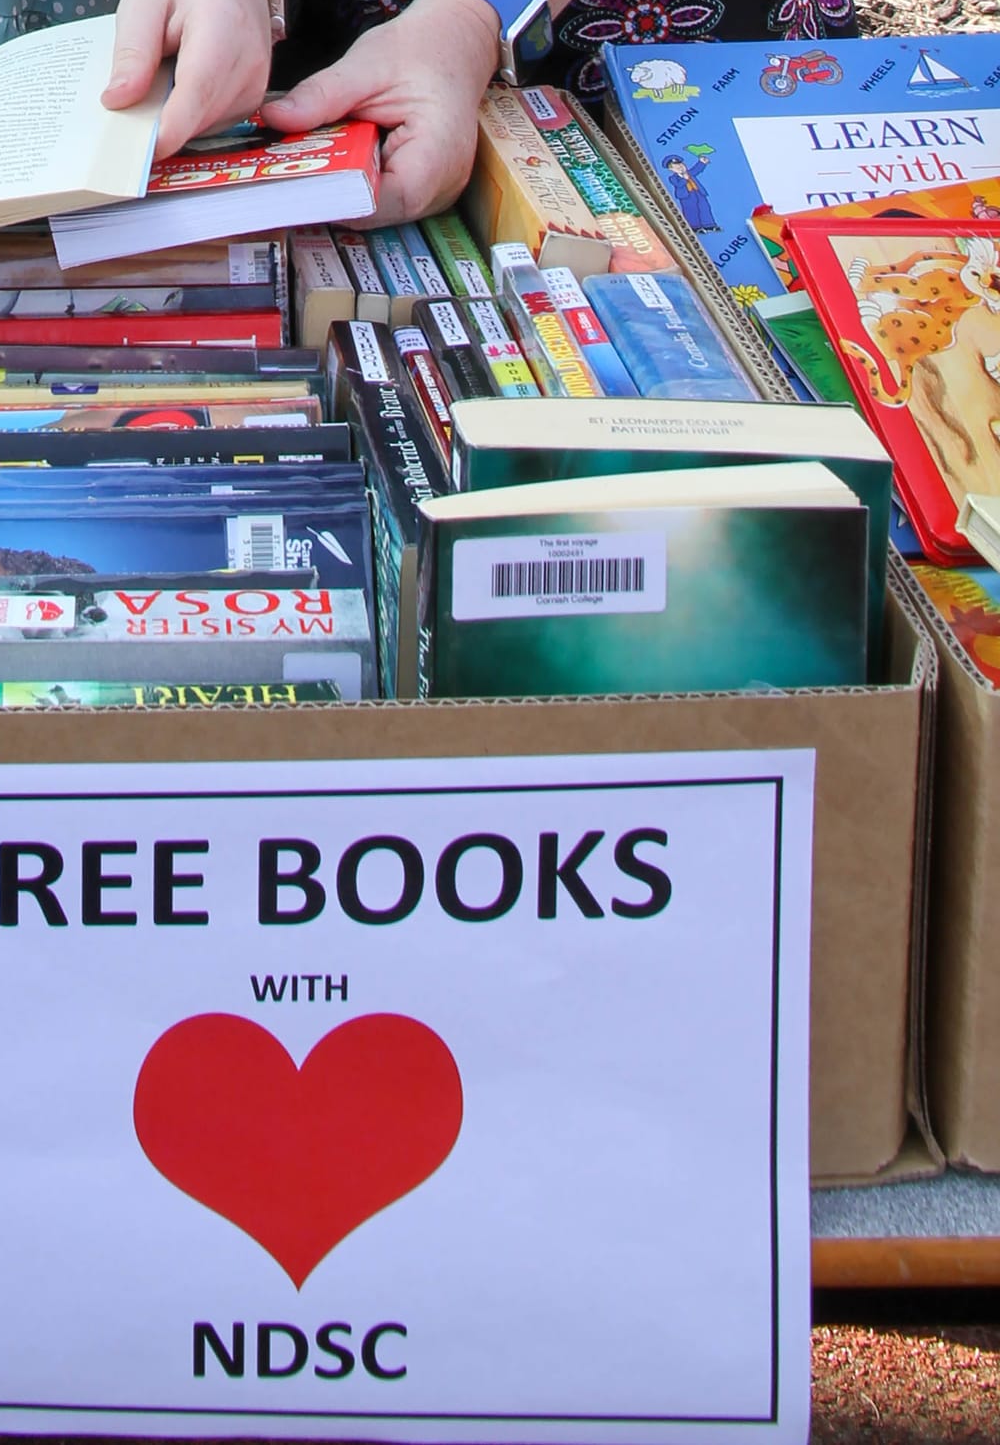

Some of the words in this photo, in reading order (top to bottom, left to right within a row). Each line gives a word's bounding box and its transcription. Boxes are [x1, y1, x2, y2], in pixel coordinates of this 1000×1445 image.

[712, 68, 738, 93] FARM
[859, 58, 896, 93] WHEELS
[656, 107, 699, 146] STATION
[801, 117, 986, 151] LEARN
[561, 128, 599, 164] CHASE
[148, 158, 330, 187] OLG
[859, 153, 967, 183] with
[599, 218, 628, 248] ZIZOU
[616, 215, 652, 254] CORDER
[717, 235, 748, 269] LOURS
[533, 314, 577, 362] RECORDS
[610, 425, 684, 435] PATTERSON
[688, 425, 731, 435] RIVER
[686, 418, 745, 429] COLLEGE
[539, 539, 553, 547] The
[572, 538, 598, 547] voyage
[114, 590, 332, 616] ROSA
[536, 595, 568, 605] Cornish
[571, 595, 603, 604] College
[126, 618, 255, 636] SISTER
[273, 617, 334, 636] MY
[258, 827, 671, 926] BOOKS
[250, 974, 348, 1002] WITH
[193, 1322, 408, 1380] NDSC
